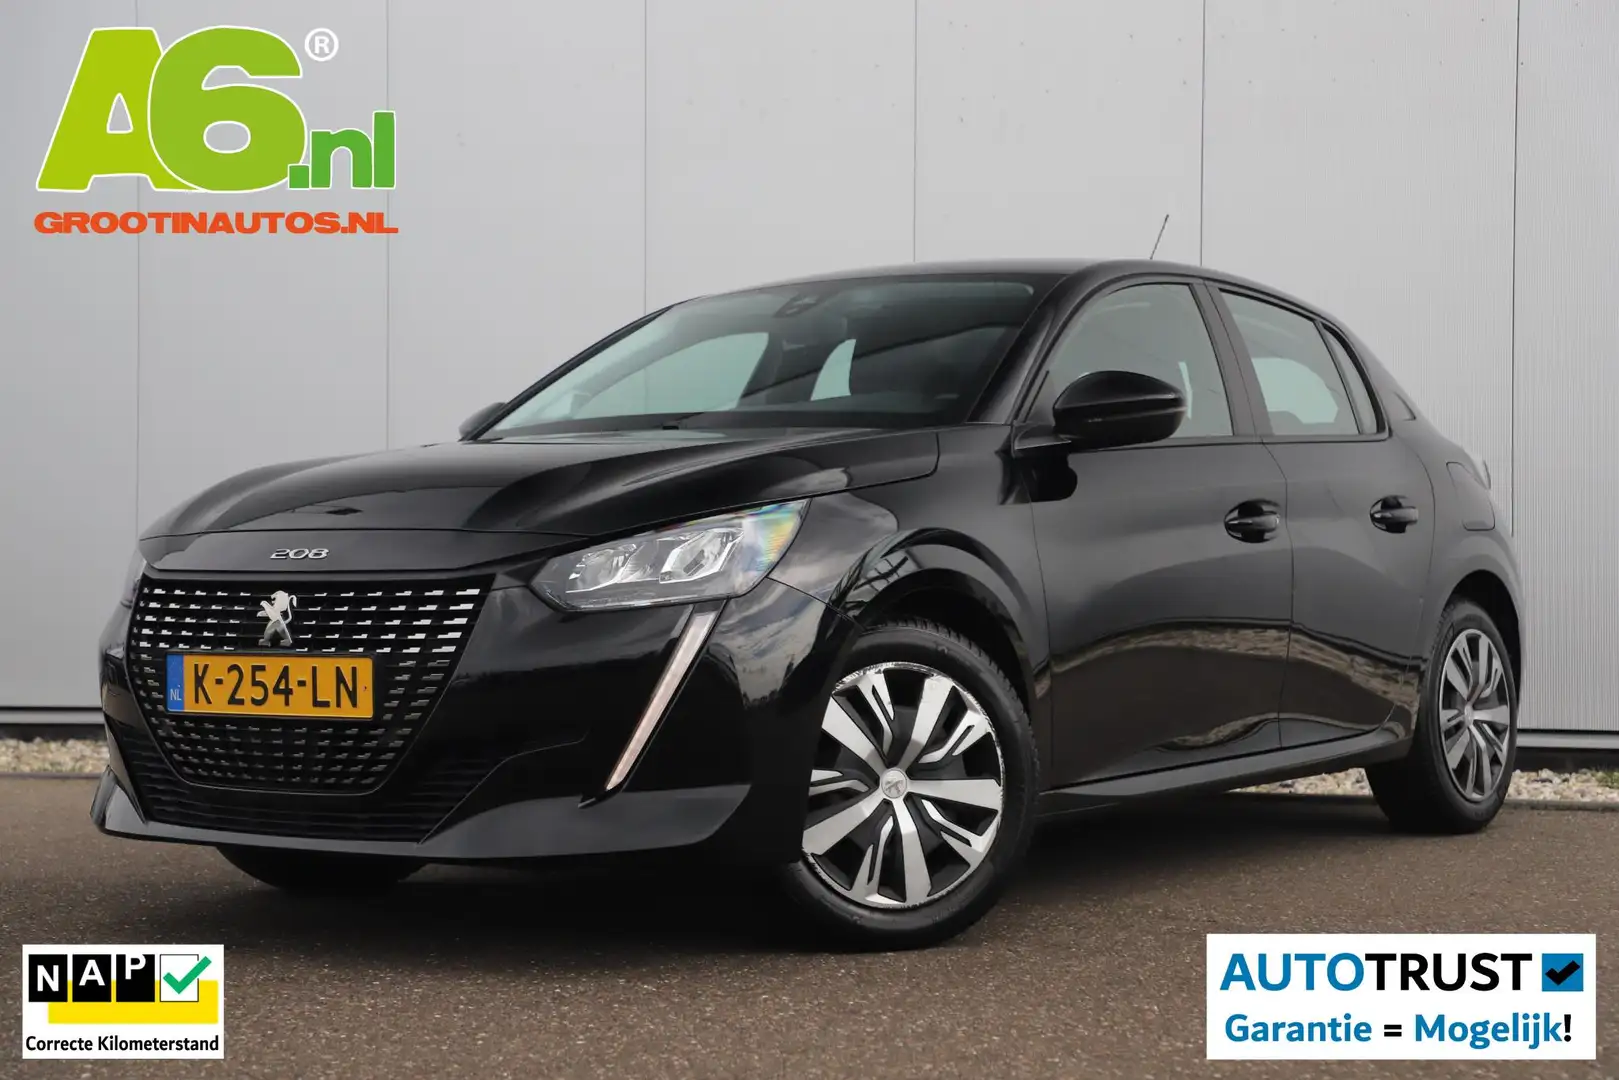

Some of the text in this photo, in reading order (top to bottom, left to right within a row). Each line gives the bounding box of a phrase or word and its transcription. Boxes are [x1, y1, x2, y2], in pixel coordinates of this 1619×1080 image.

[270, 548, 329, 560] 208
[193, 663, 358, 708] K-254-LN
[170, 688, 182, 701] NL
